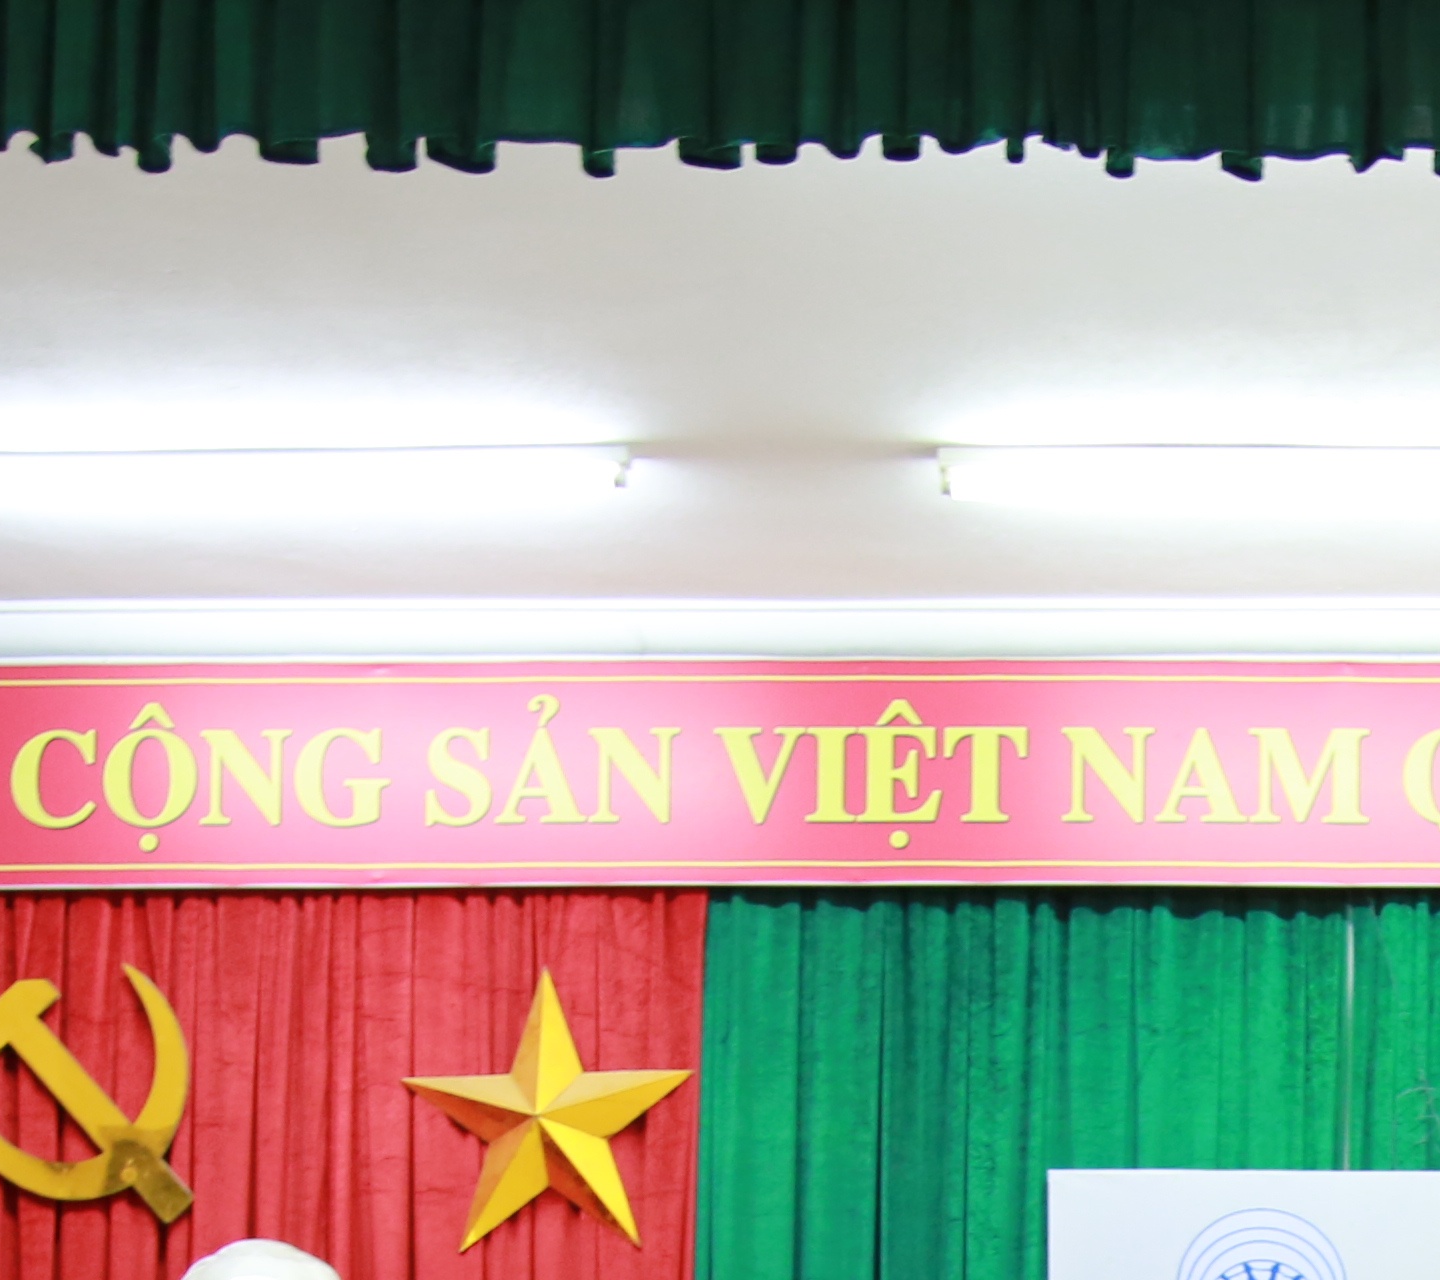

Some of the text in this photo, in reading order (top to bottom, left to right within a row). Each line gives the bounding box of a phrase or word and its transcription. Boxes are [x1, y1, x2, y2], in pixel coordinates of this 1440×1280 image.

[11, 703, 390, 852] CỘNG
[426, 695, 681, 827] SẢN
[715, 699, 1029, 849] VIỆT
[1062, 727, 1370, 824] NAM
